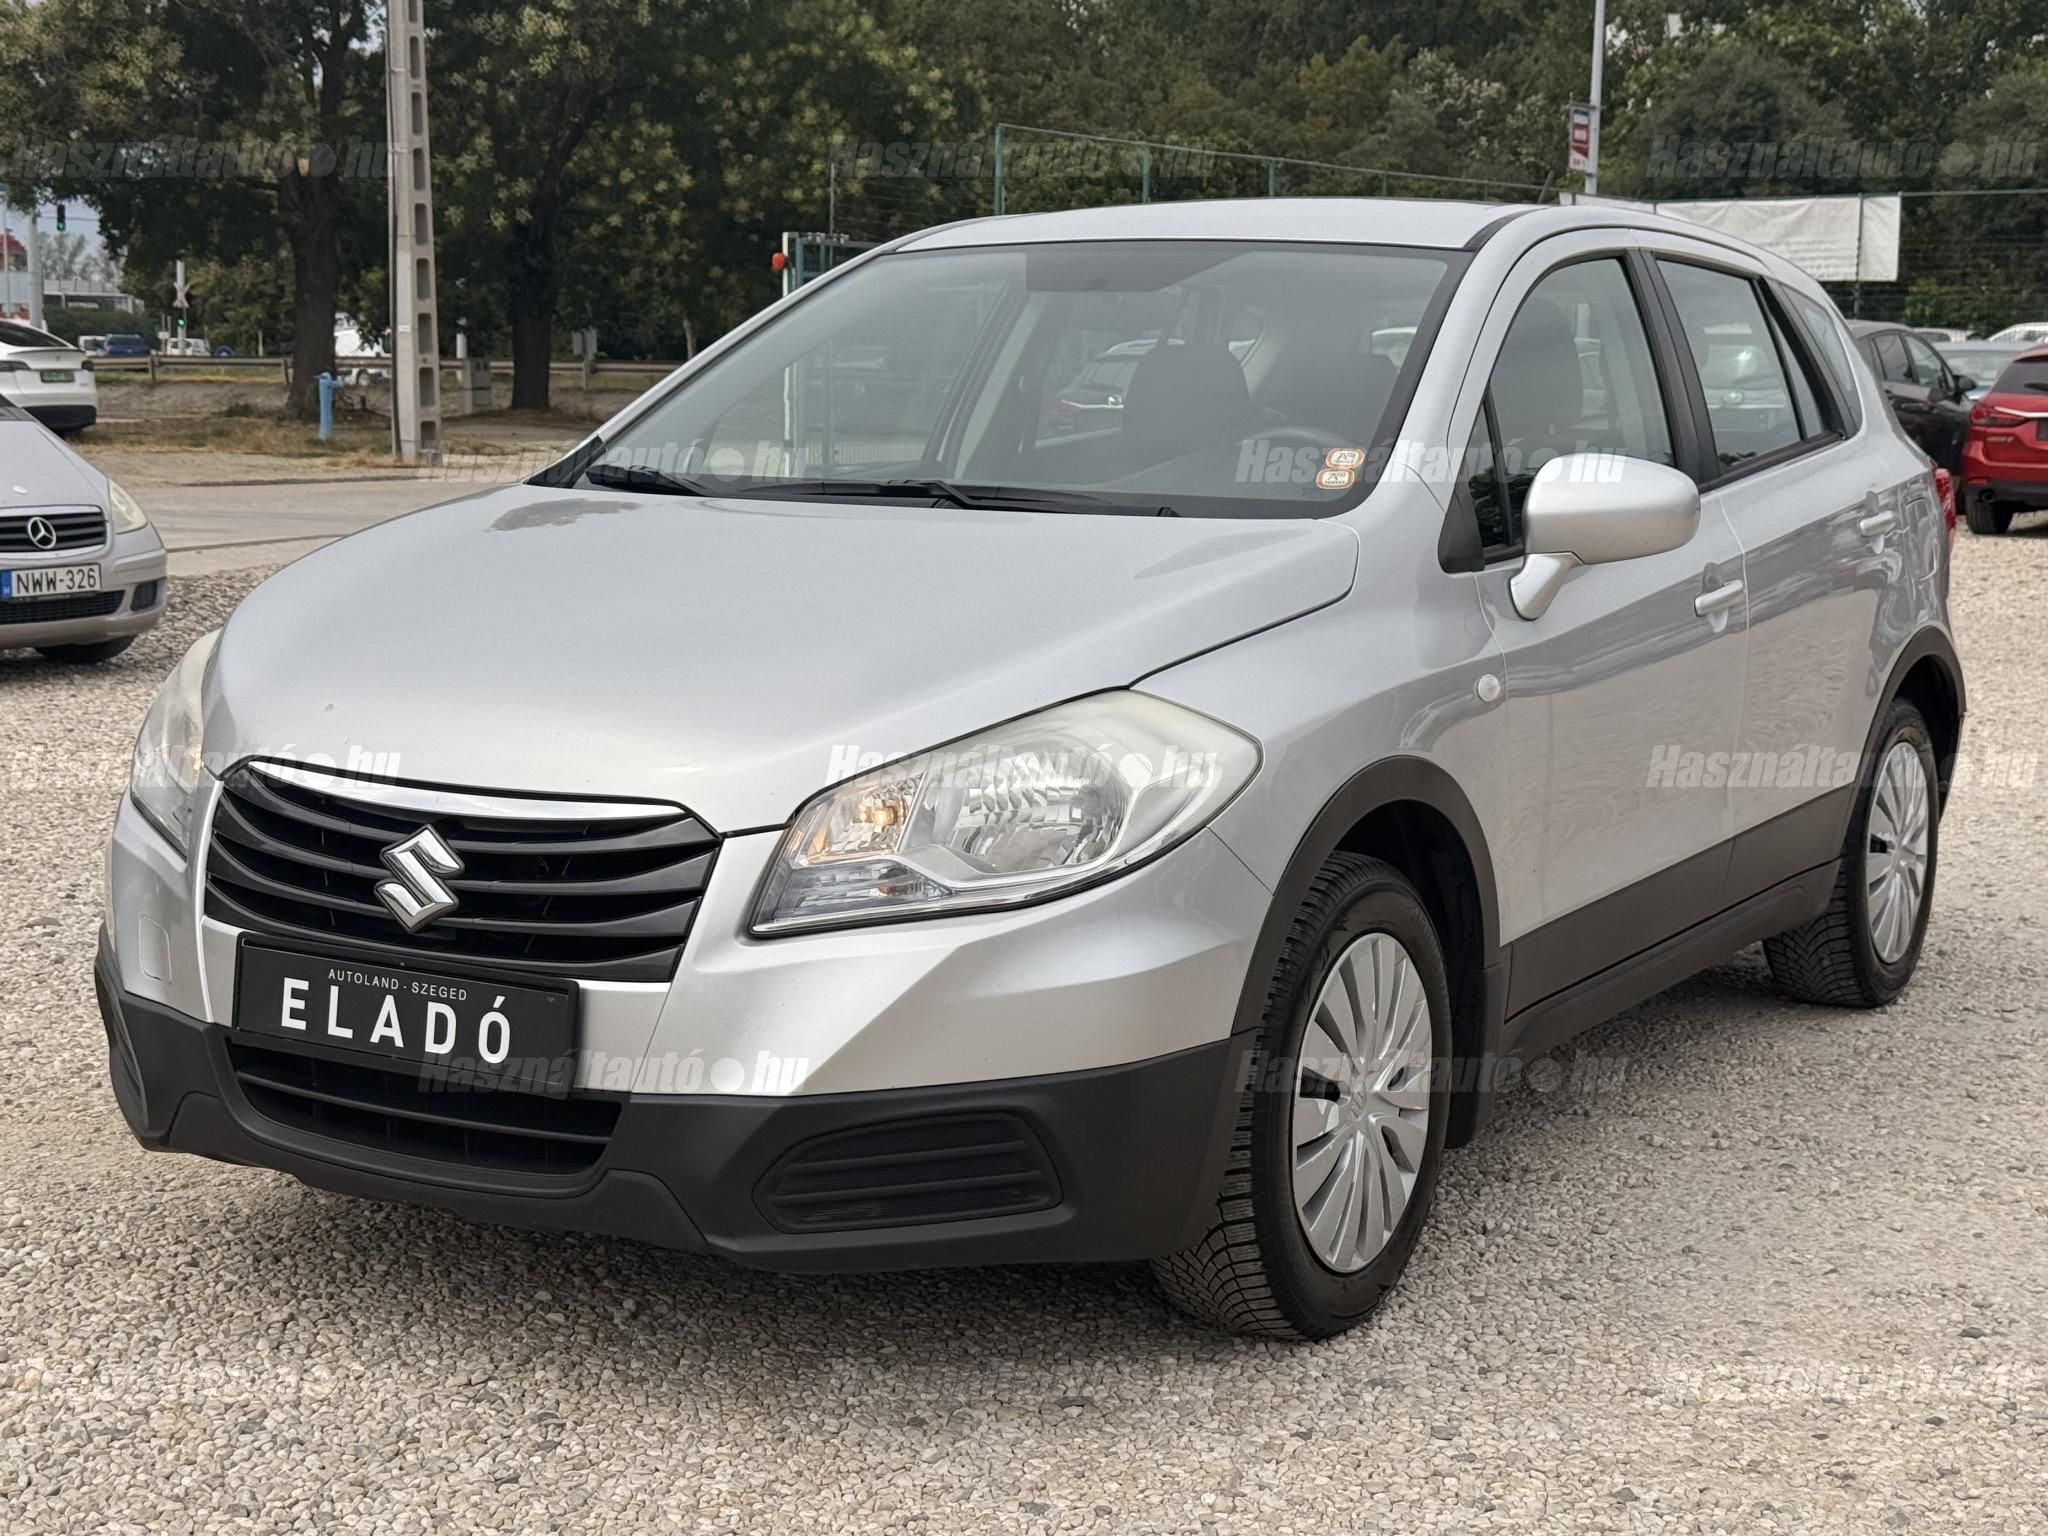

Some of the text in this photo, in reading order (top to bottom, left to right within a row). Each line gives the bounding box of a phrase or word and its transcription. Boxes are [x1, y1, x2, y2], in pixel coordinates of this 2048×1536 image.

[16, 568, 97, 594] NWW-326
[328, 968, 400, 990] AUTOLAND
[411, 982, 467, 1001] SZEGED
[281, 976, 511, 1064] ELADÓ
